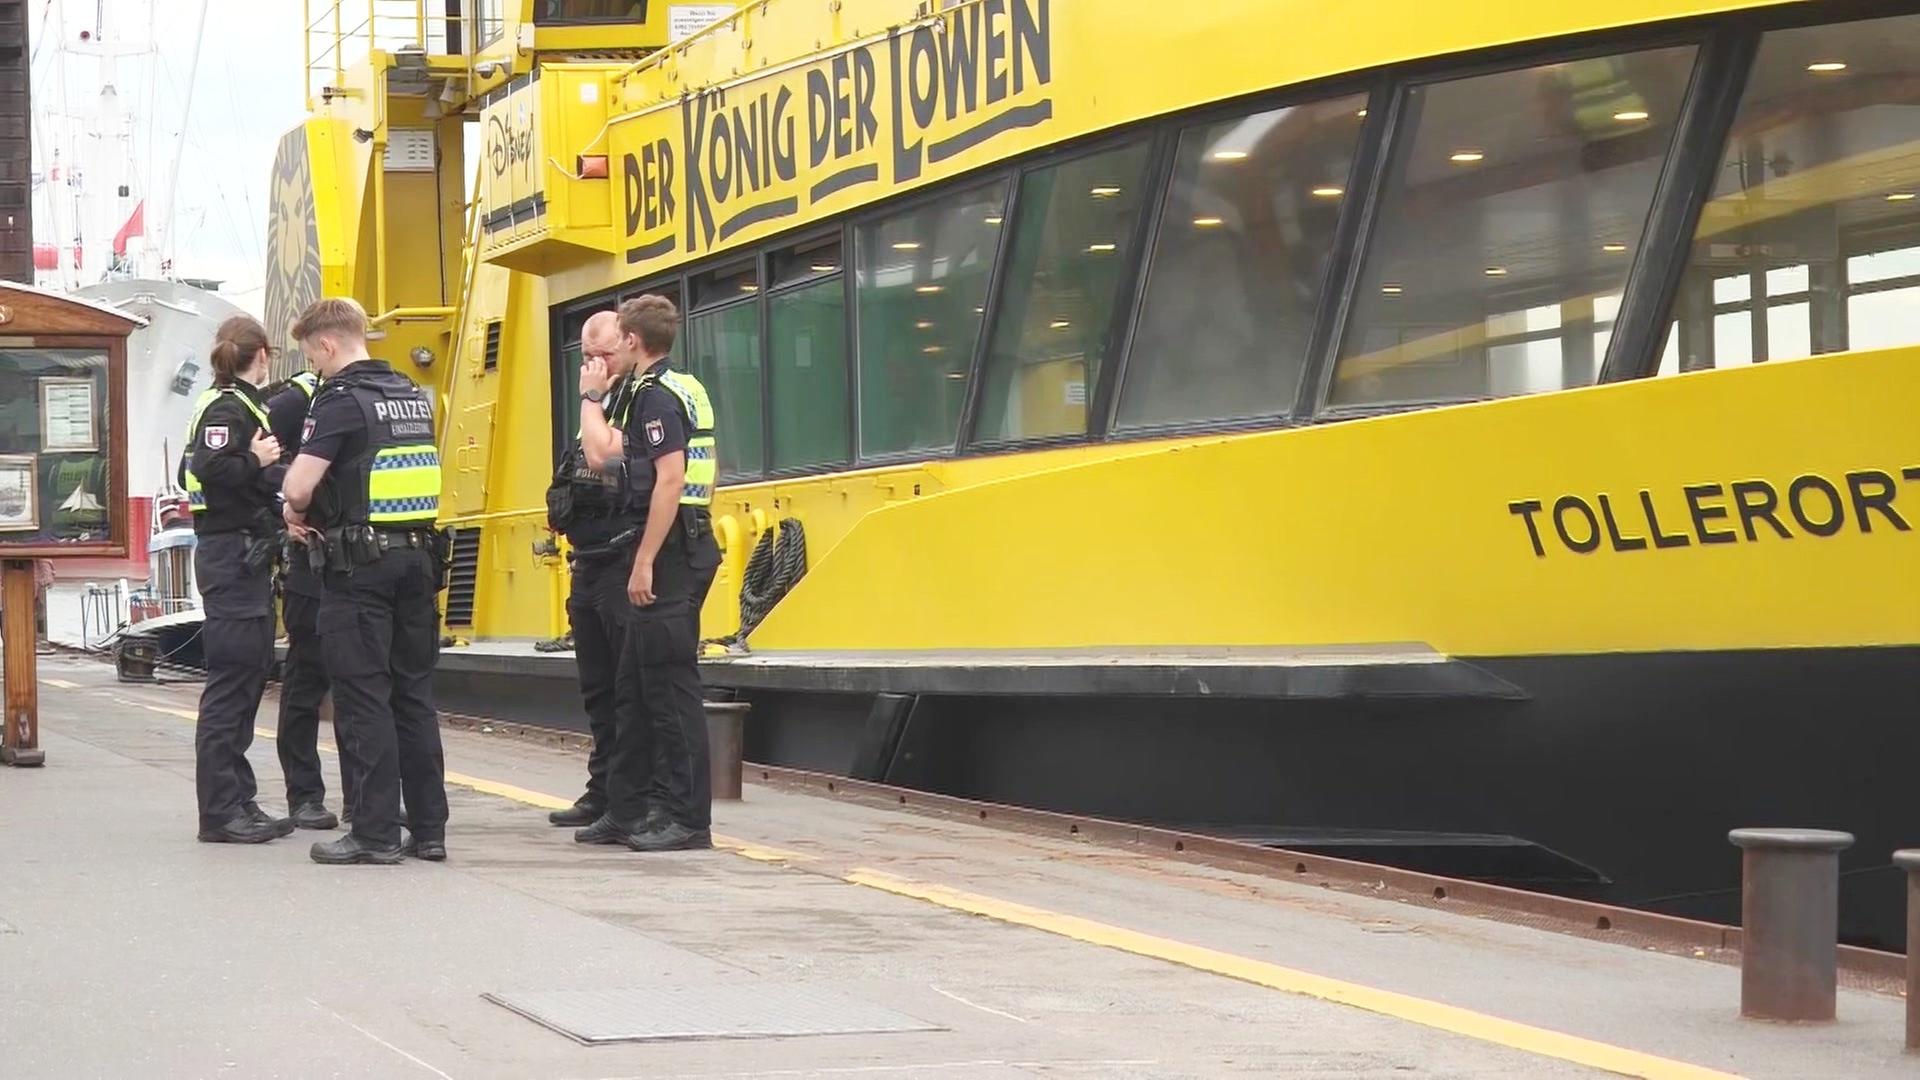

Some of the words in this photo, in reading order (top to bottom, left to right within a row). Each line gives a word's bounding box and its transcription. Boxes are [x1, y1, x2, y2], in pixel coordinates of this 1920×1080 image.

[624, 138, 675, 237] DER
[682, 84, 797, 253] KÖNIG
[807, 47, 878, 169] DER
[374, 399, 432, 421] POLIZEI
